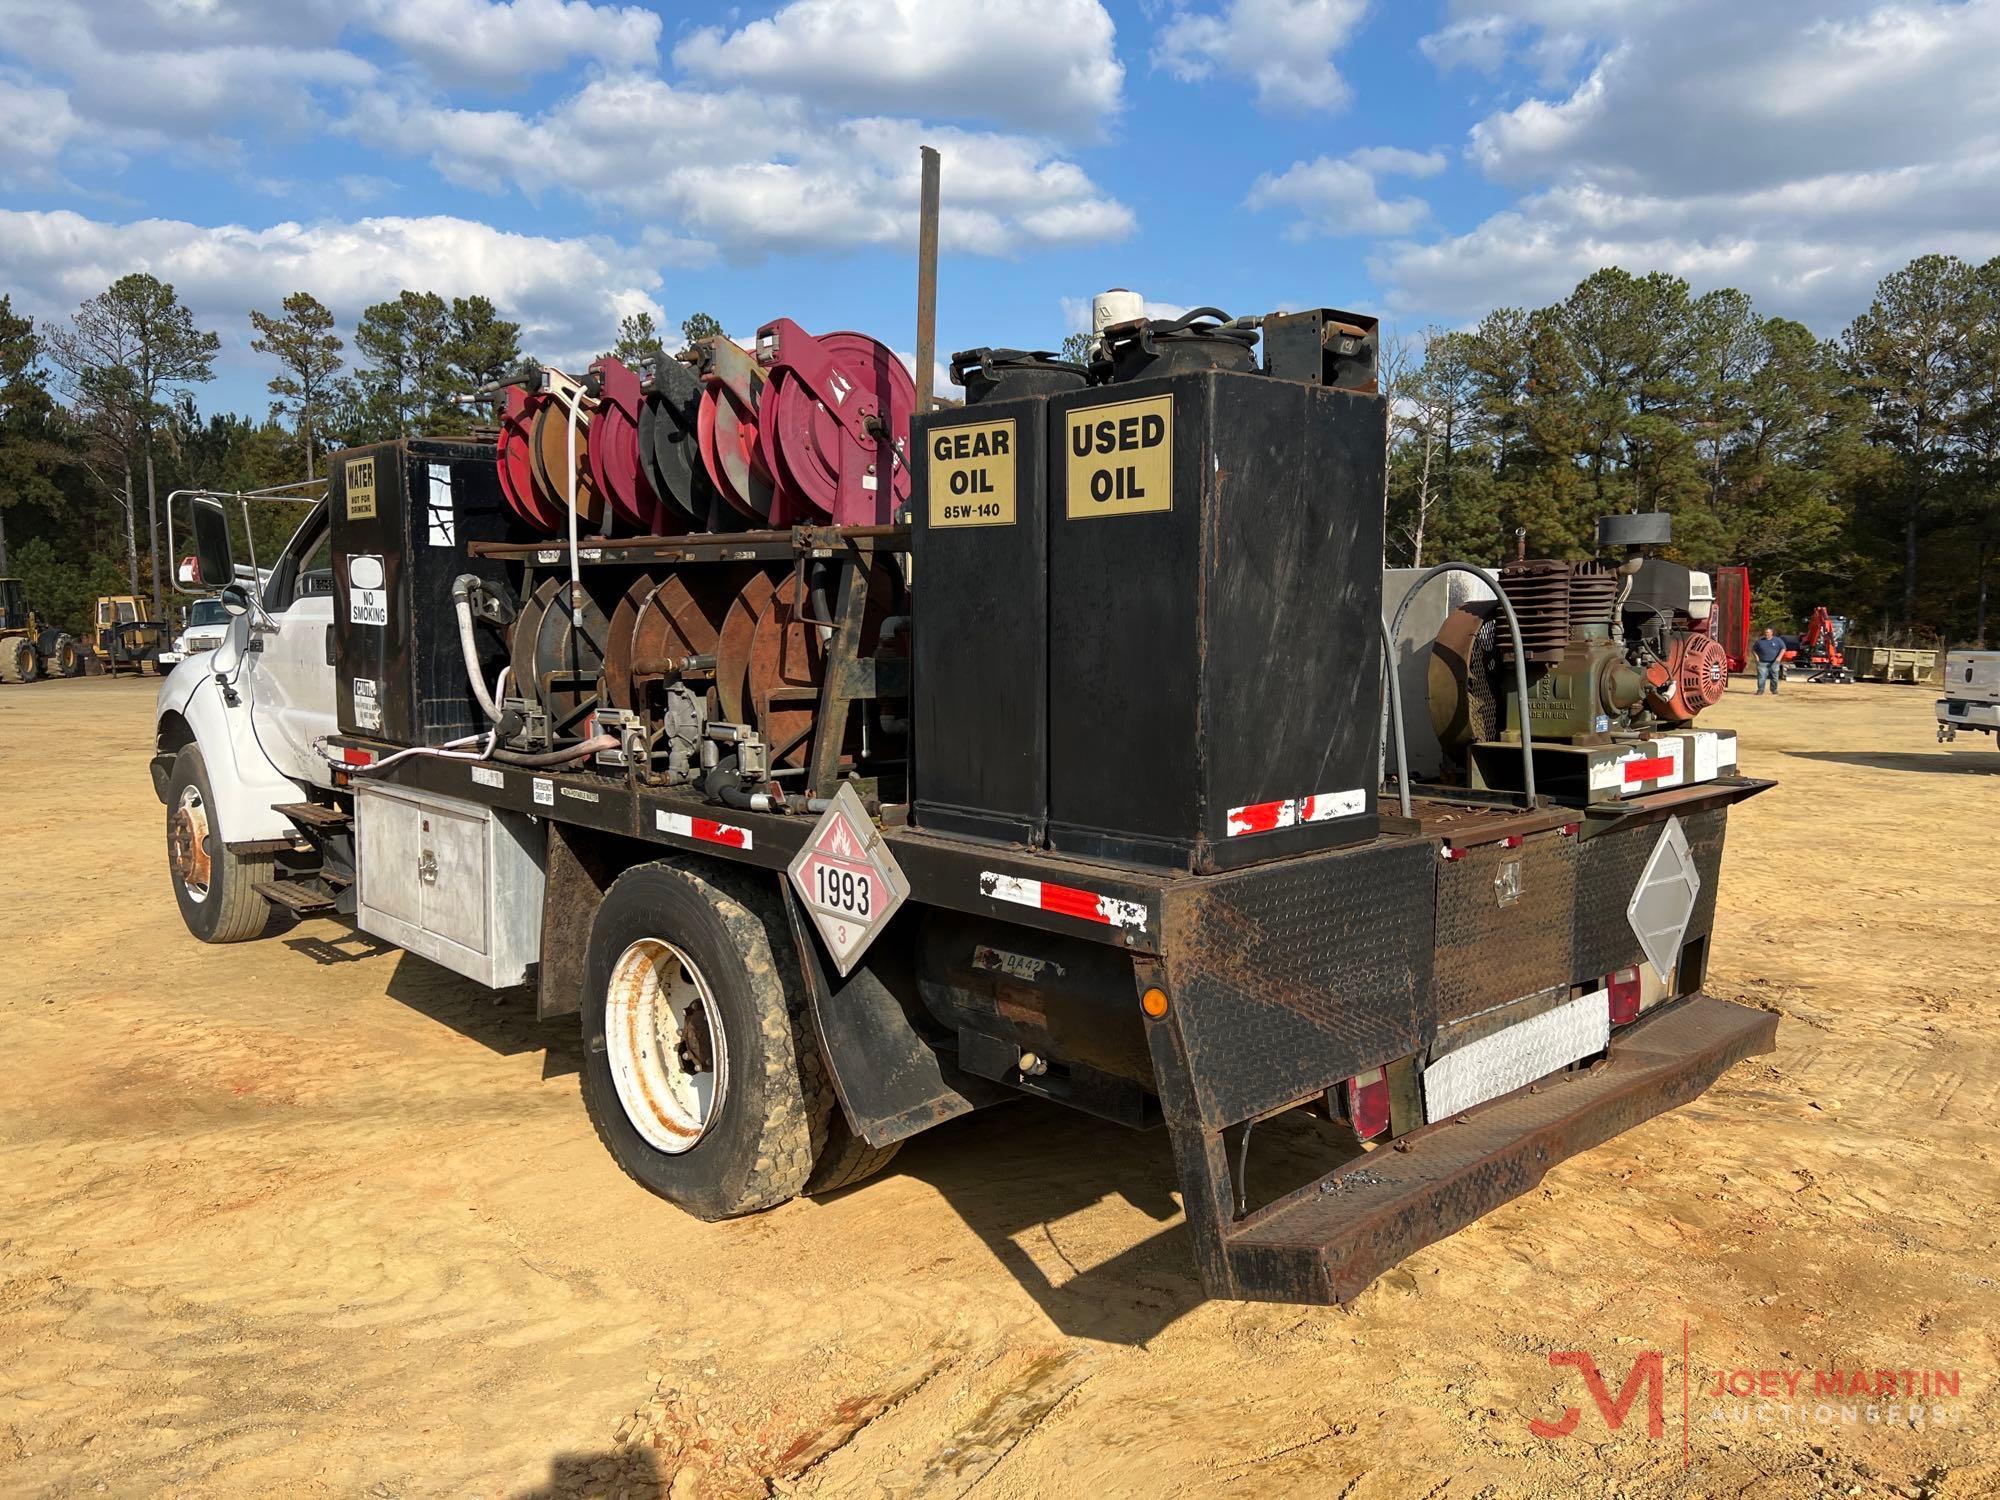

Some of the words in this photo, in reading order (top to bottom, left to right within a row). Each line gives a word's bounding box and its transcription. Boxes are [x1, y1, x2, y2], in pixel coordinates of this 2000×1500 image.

[934, 430, 1010, 461] GEAR
[1072, 414, 1165, 457] USED
[348, 463, 373, 490] WATER
[949, 469, 994, 495] OIL
[1090, 466, 1145, 502] OIL
[944, 503, 1000, 519] 85W-140
[363, 591, 374, 606] NO
[353, 606, 385, 622] SMOKING
[816, 865, 870, 917] 1993
[838, 925, 847, 944] 3
